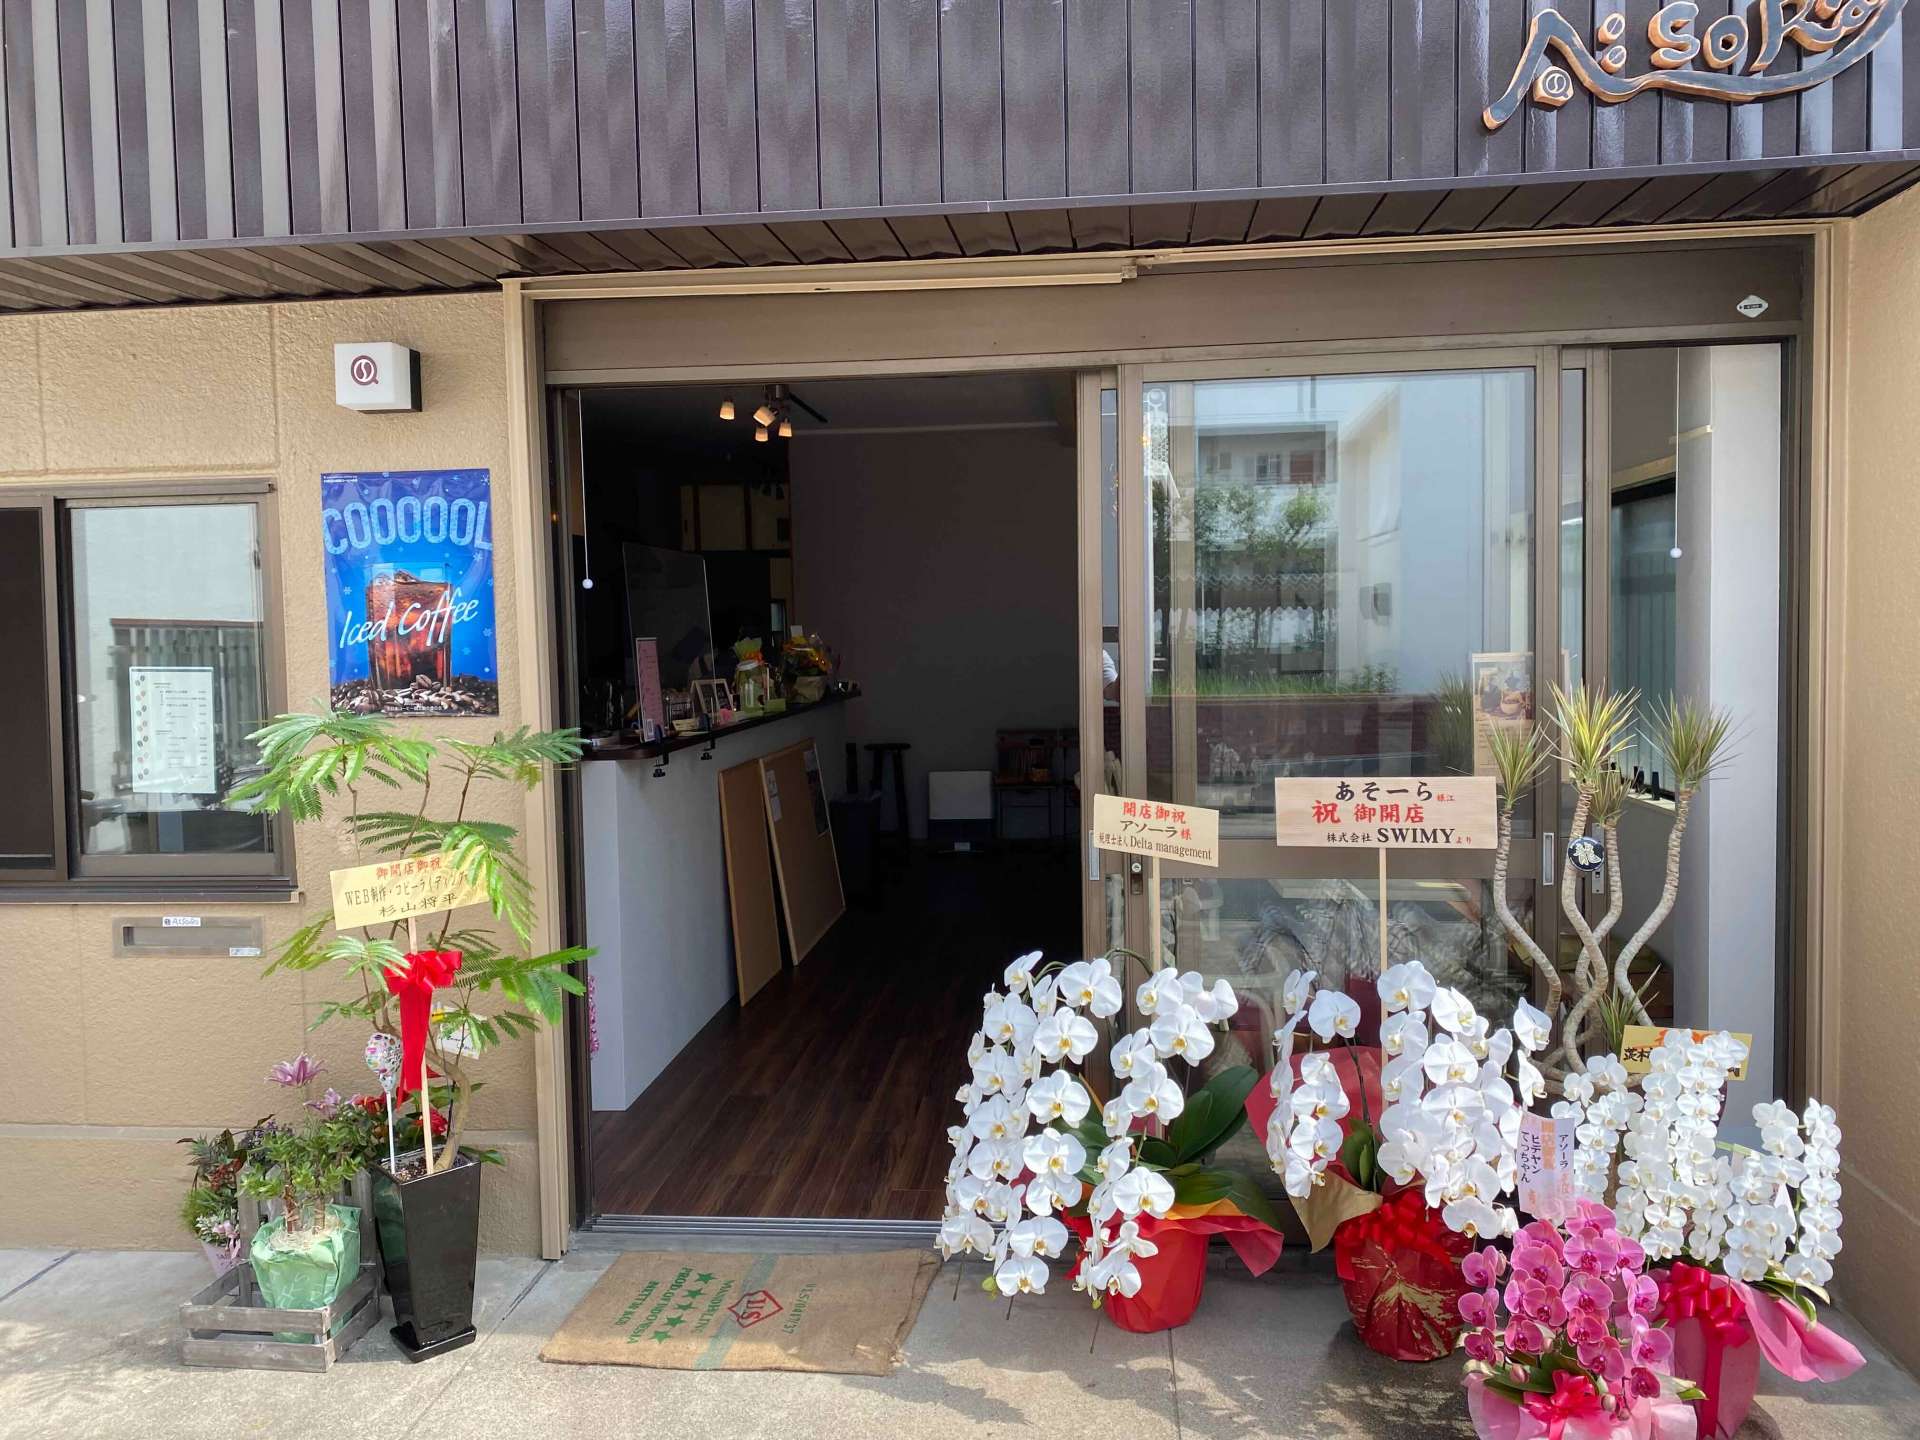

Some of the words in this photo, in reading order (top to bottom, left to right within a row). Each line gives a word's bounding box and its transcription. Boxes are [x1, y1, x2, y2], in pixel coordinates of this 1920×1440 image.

[339, 601, 394, 649] Iced
[398, 587, 480, 647] Coffee
[1123, 802, 1186, 824] 開店御祝
[1312, 800, 1341, 824] 祝
[1354, 803, 1425, 824] 御開店
[1327, 832, 1372, 843] 株式会社
[1377, 827, 1455, 844] SWIMY
[1130, 836, 1153, 849] Delta
[1155, 842, 1212, 860] management
[1559, 1134, 1568, 1169] アソーラ
